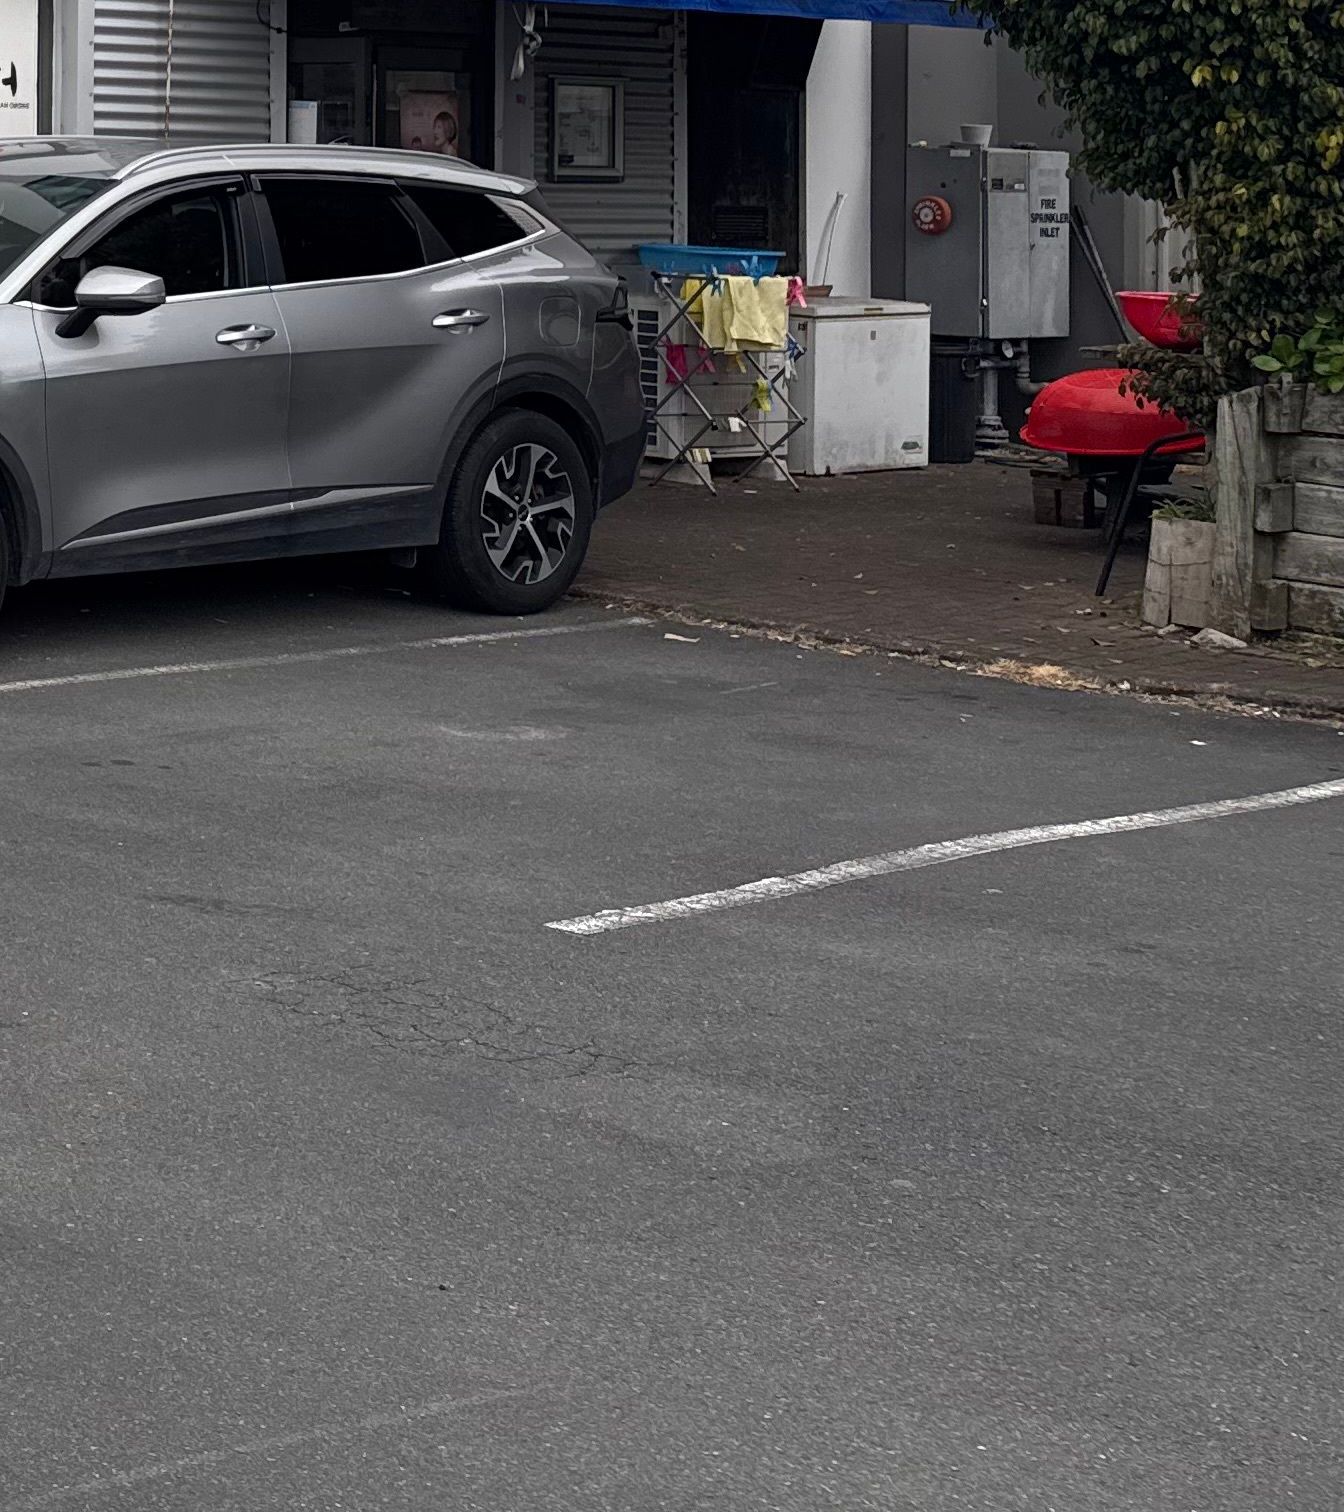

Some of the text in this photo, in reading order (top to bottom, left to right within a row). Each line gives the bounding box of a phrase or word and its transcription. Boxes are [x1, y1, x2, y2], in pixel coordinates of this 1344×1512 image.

[1040, 198, 1057, 210] FIRE
[1030, 212, 1070, 224] SPRINKLER
[1039, 226, 1060, 238] INLET
